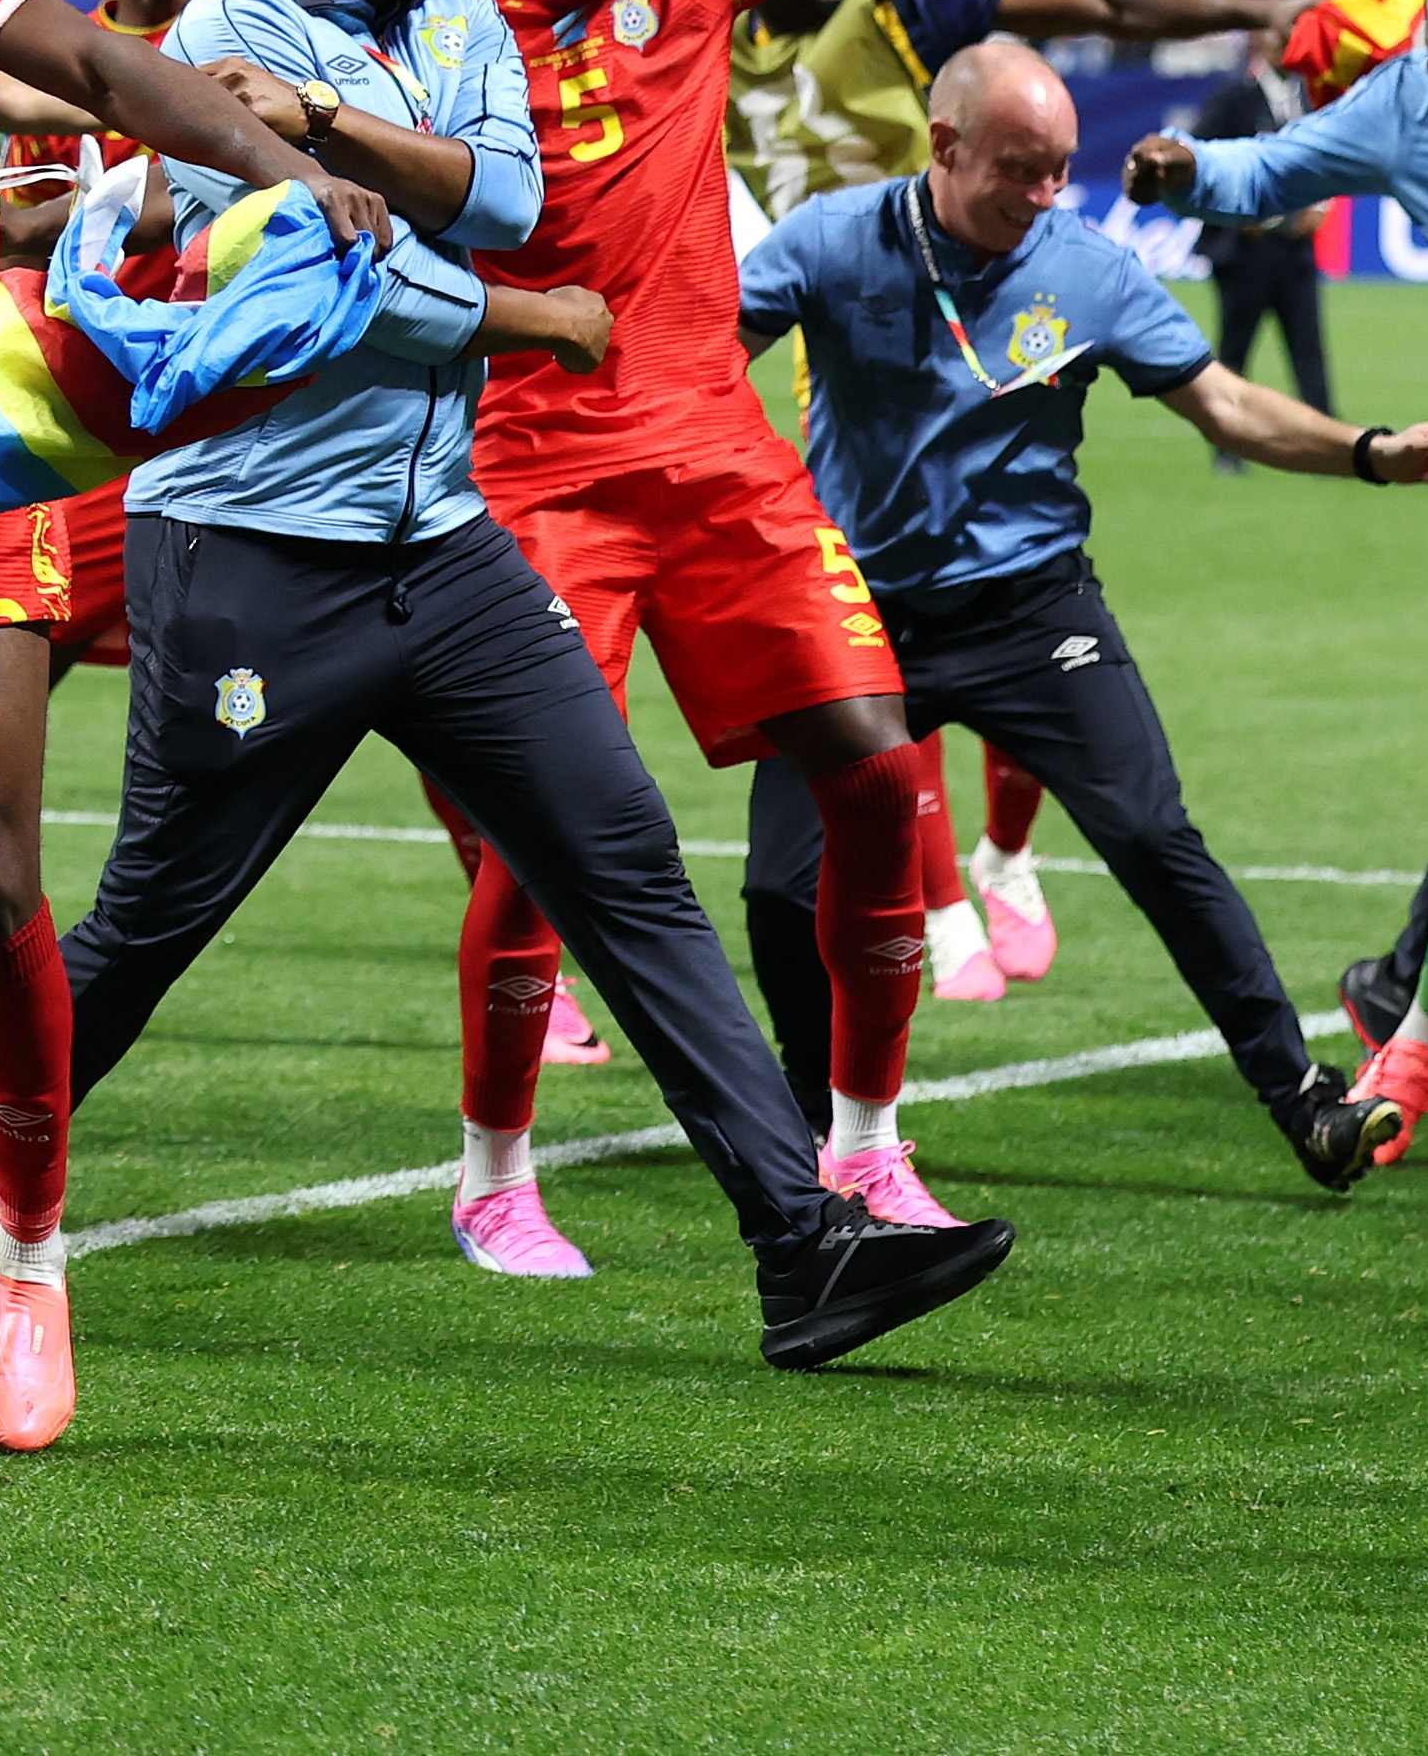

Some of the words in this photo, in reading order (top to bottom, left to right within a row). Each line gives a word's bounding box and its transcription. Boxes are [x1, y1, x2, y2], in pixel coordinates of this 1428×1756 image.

[335, 76, 370, 86] umbro
[559, 68, 624, 162] 5
[813, 527, 872, 604] 5
